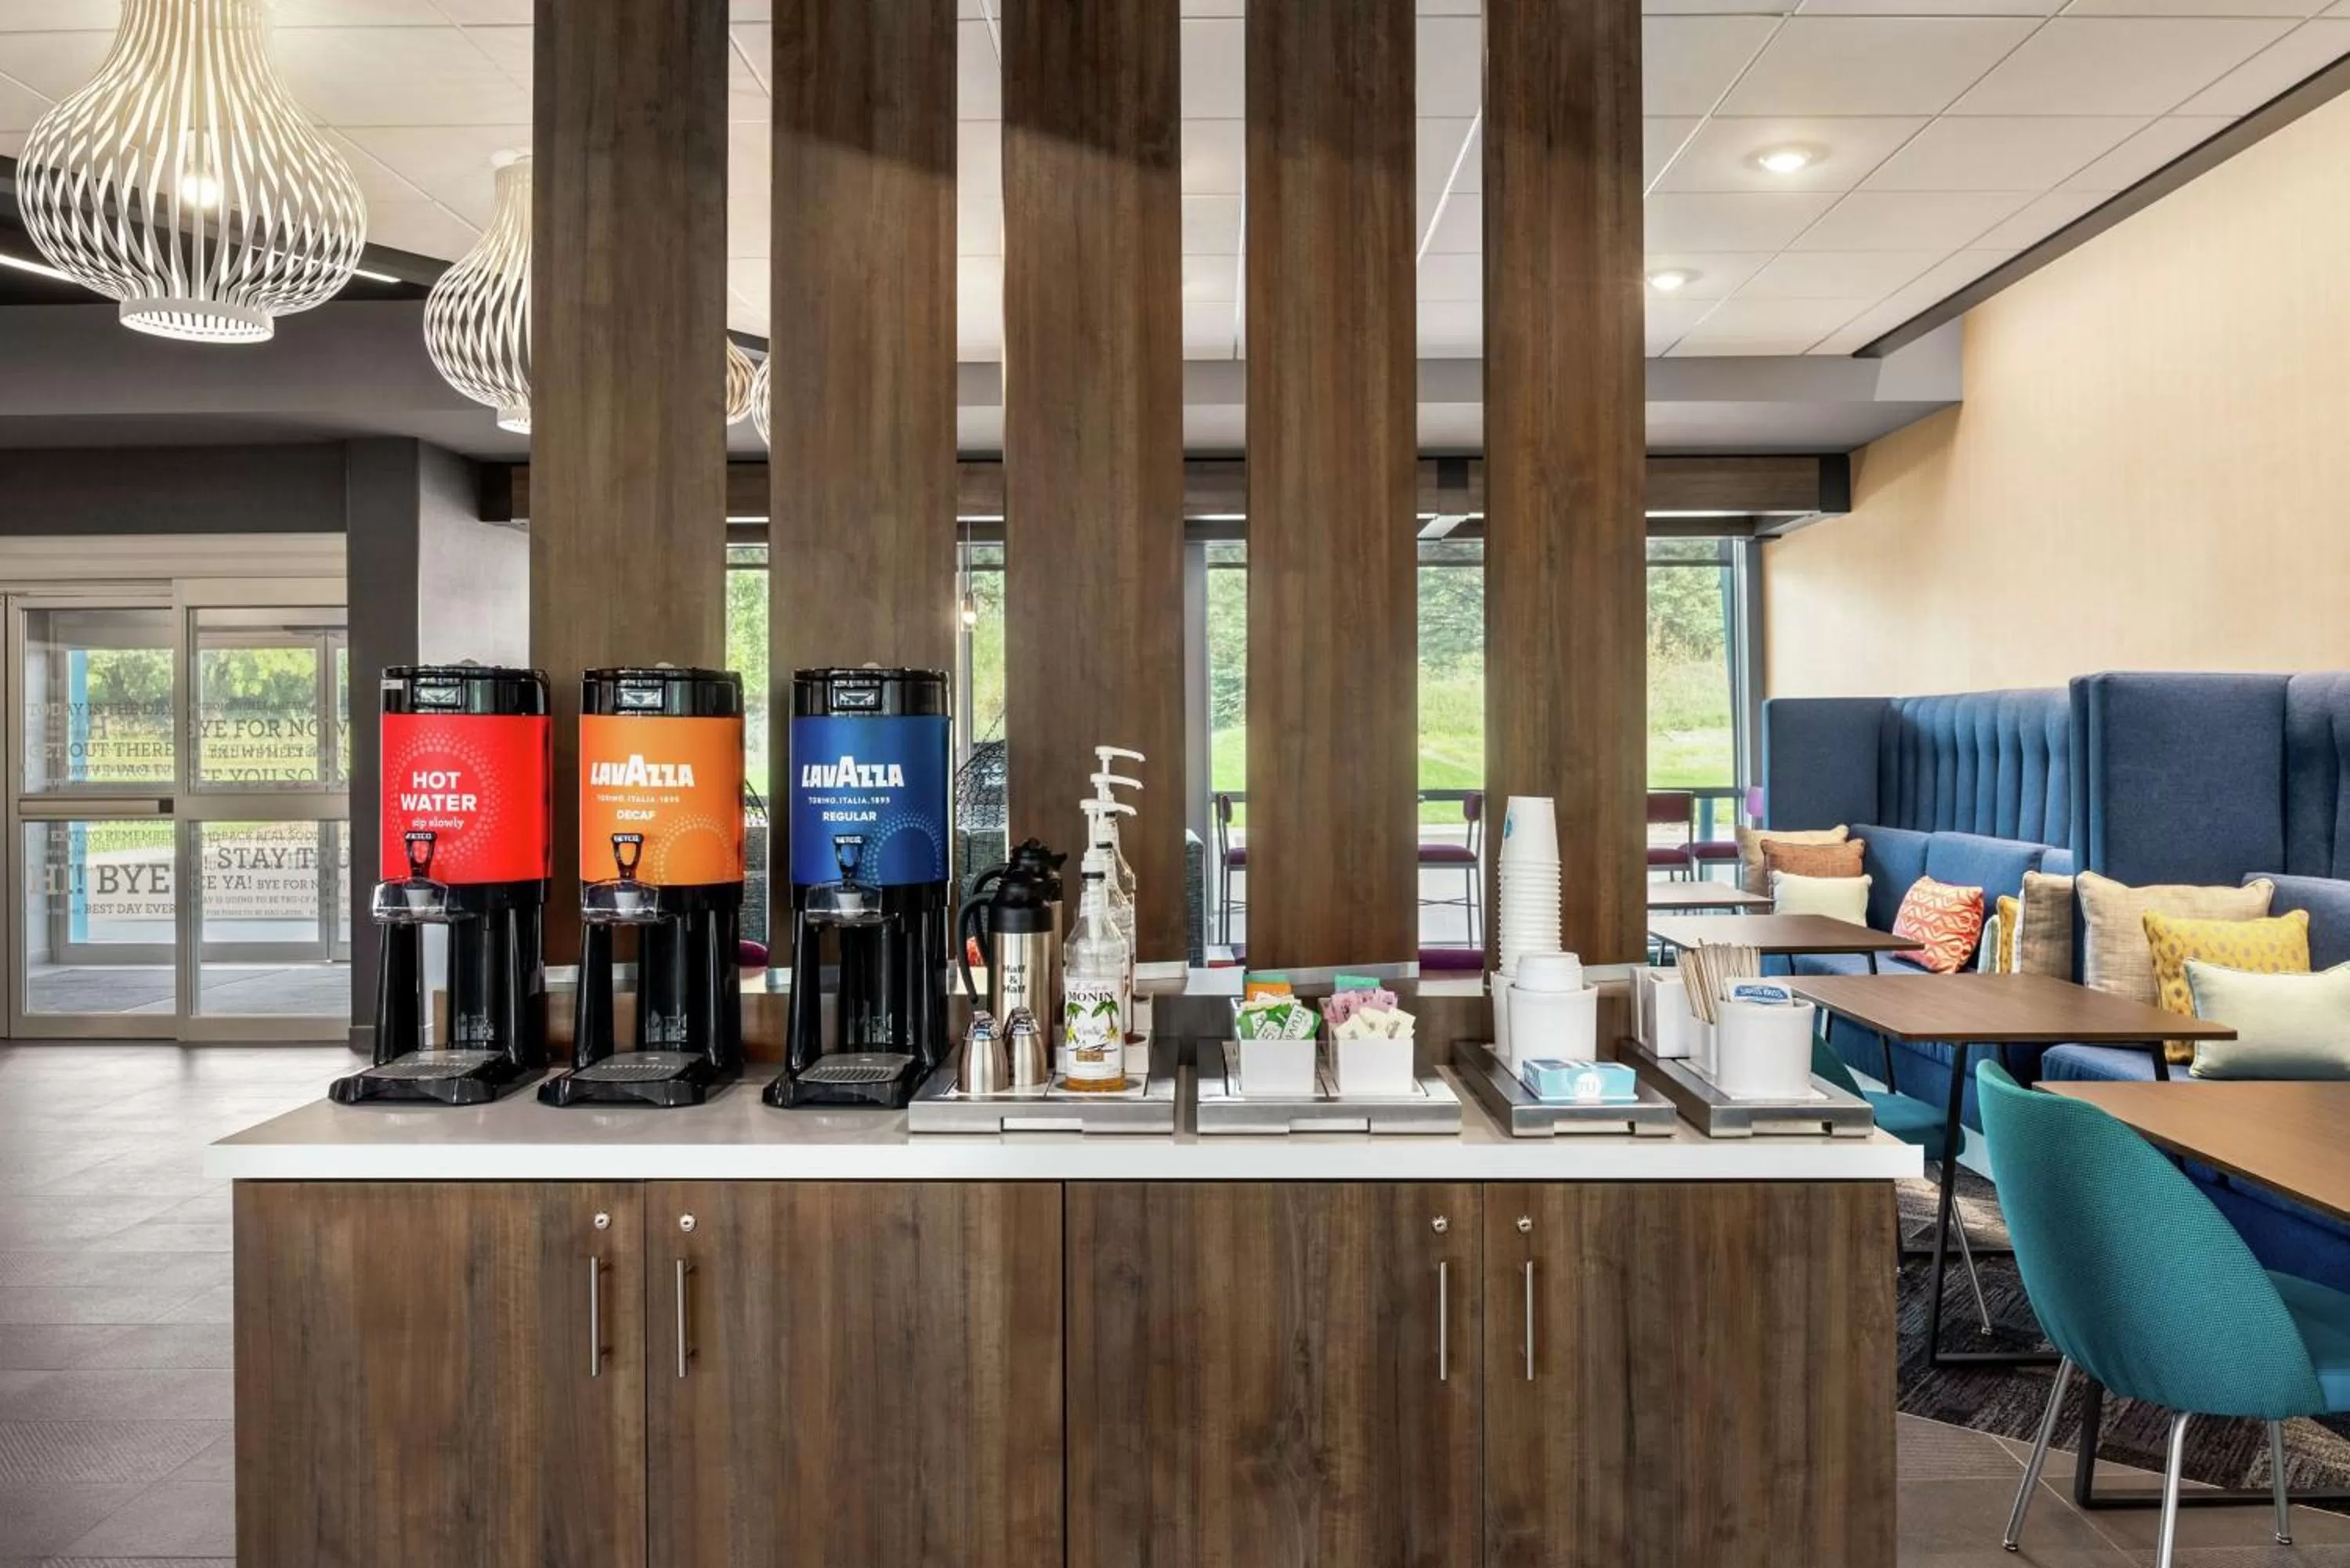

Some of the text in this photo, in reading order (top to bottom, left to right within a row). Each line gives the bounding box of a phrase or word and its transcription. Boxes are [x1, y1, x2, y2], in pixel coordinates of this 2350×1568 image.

[235, 719, 281, 738] FOR
[70, 742, 110, 758] OUT
[114, 742, 174, 758] THERE
[590, 754, 695, 787] LAVAZZA
[801, 756, 905, 788] LAVAZZA
[413, 771, 461, 789] HOT
[400, 793, 477, 811] WATER
[616, 809, 656, 820] DECAF
[822, 811, 877, 822] REGULAR
[412, 816, 465, 830] sip slowly
[218, 847, 287, 869] STAY
[96, 864, 170, 894] BYE
[222, 875, 251, 890] YA!
[284, 879, 308, 891] FOR
[85, 903, 114, 915] BEST
[117, 903, 142, 915] DAY
[1003, 964, 1025, 974] Half
[1010, 975, 1018, 985] &
[1003, 984, 1025, 993] Half
[1068, 991, 1114, 1002] MONIN
